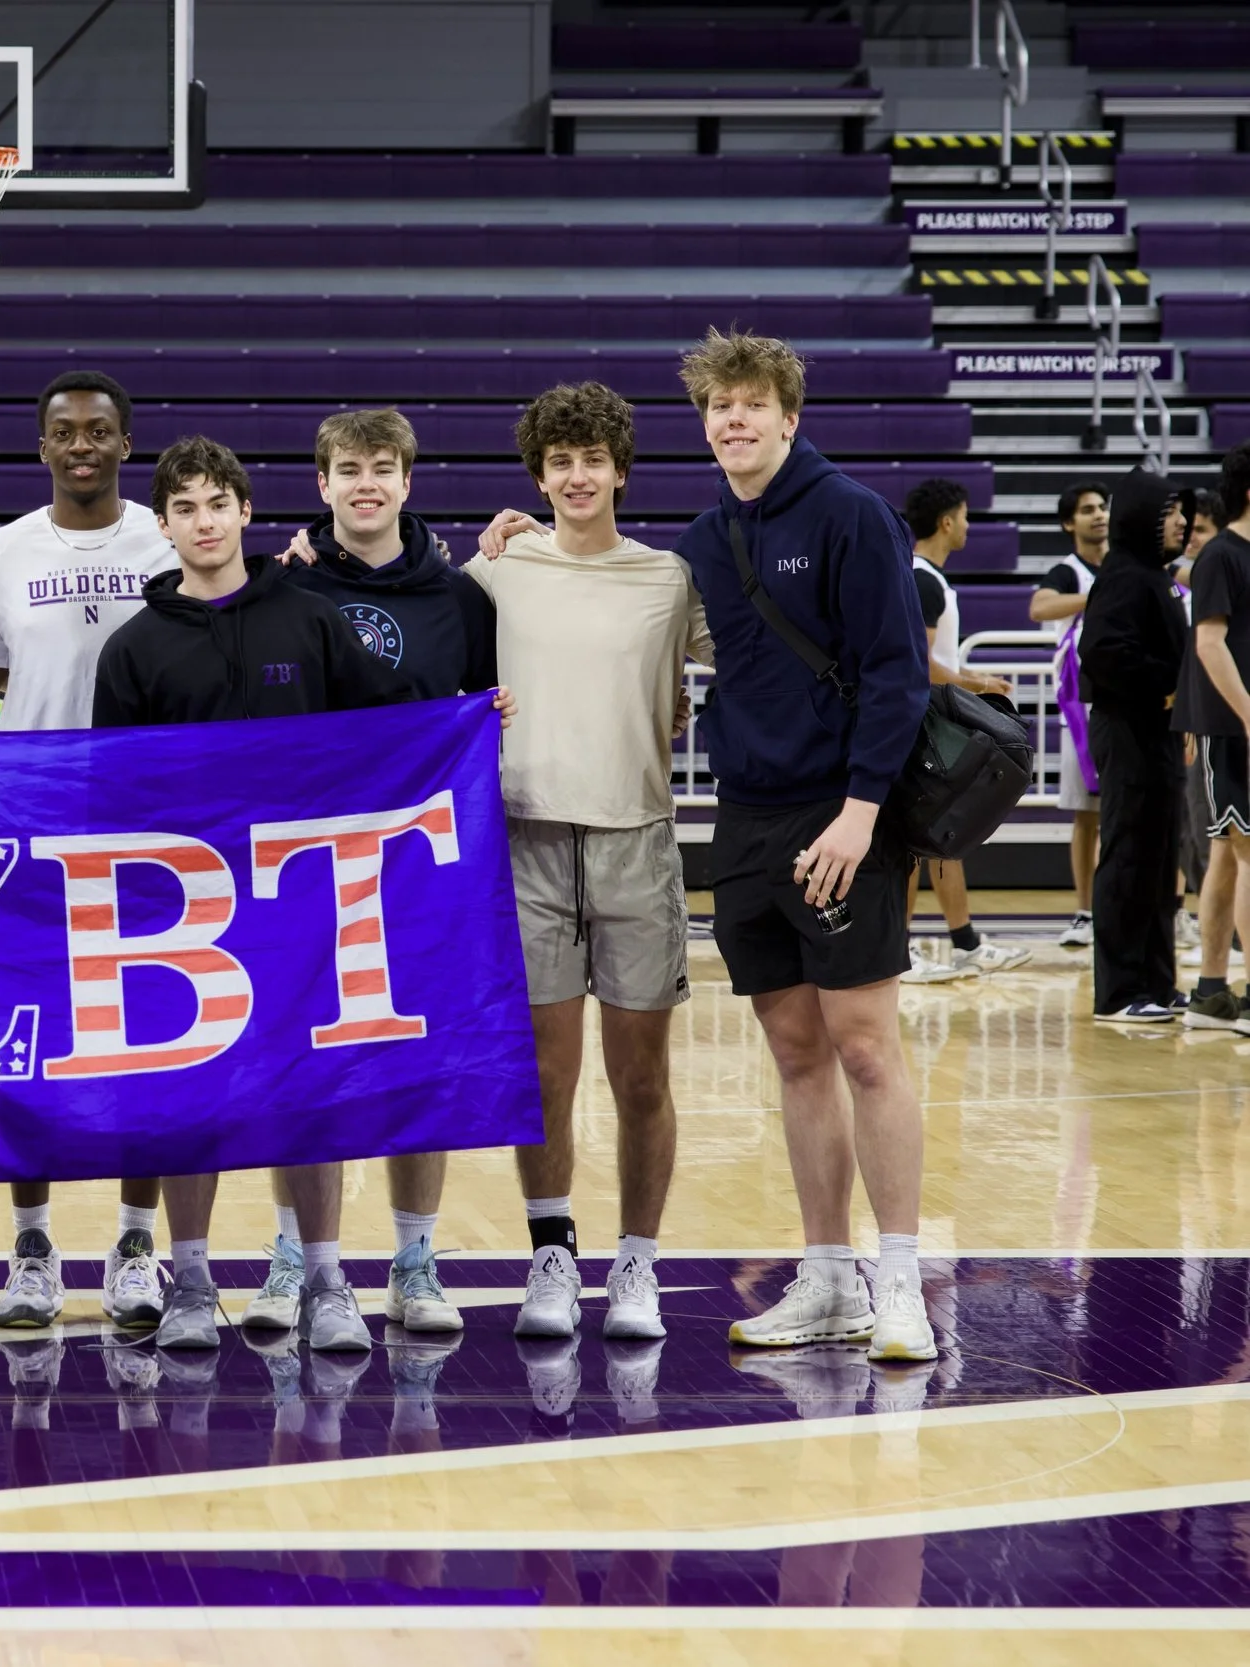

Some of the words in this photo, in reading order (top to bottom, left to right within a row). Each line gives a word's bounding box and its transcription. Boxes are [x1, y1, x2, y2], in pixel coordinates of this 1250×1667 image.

[916, 213, 975, 230] PLEASE
[976, 213, 1030, 229] WATCH
[1032, 212, 1074, 229] YOR
[1075, 212, 1115, 229] STEP
[956, 356, 1016, 372] PLEASE
[1018, 356, 1073, 372] WATCH
[1120, 356, 1161, 372] STEP
[47, 566, 129, 577] NORTHWESTERN
[777, 556, 809, 574] IMG
[28, 574, 150, 600] WILDCATS
[68, 595, 113, 603] BASKETBALL
[84, 604, 99, 624] N
